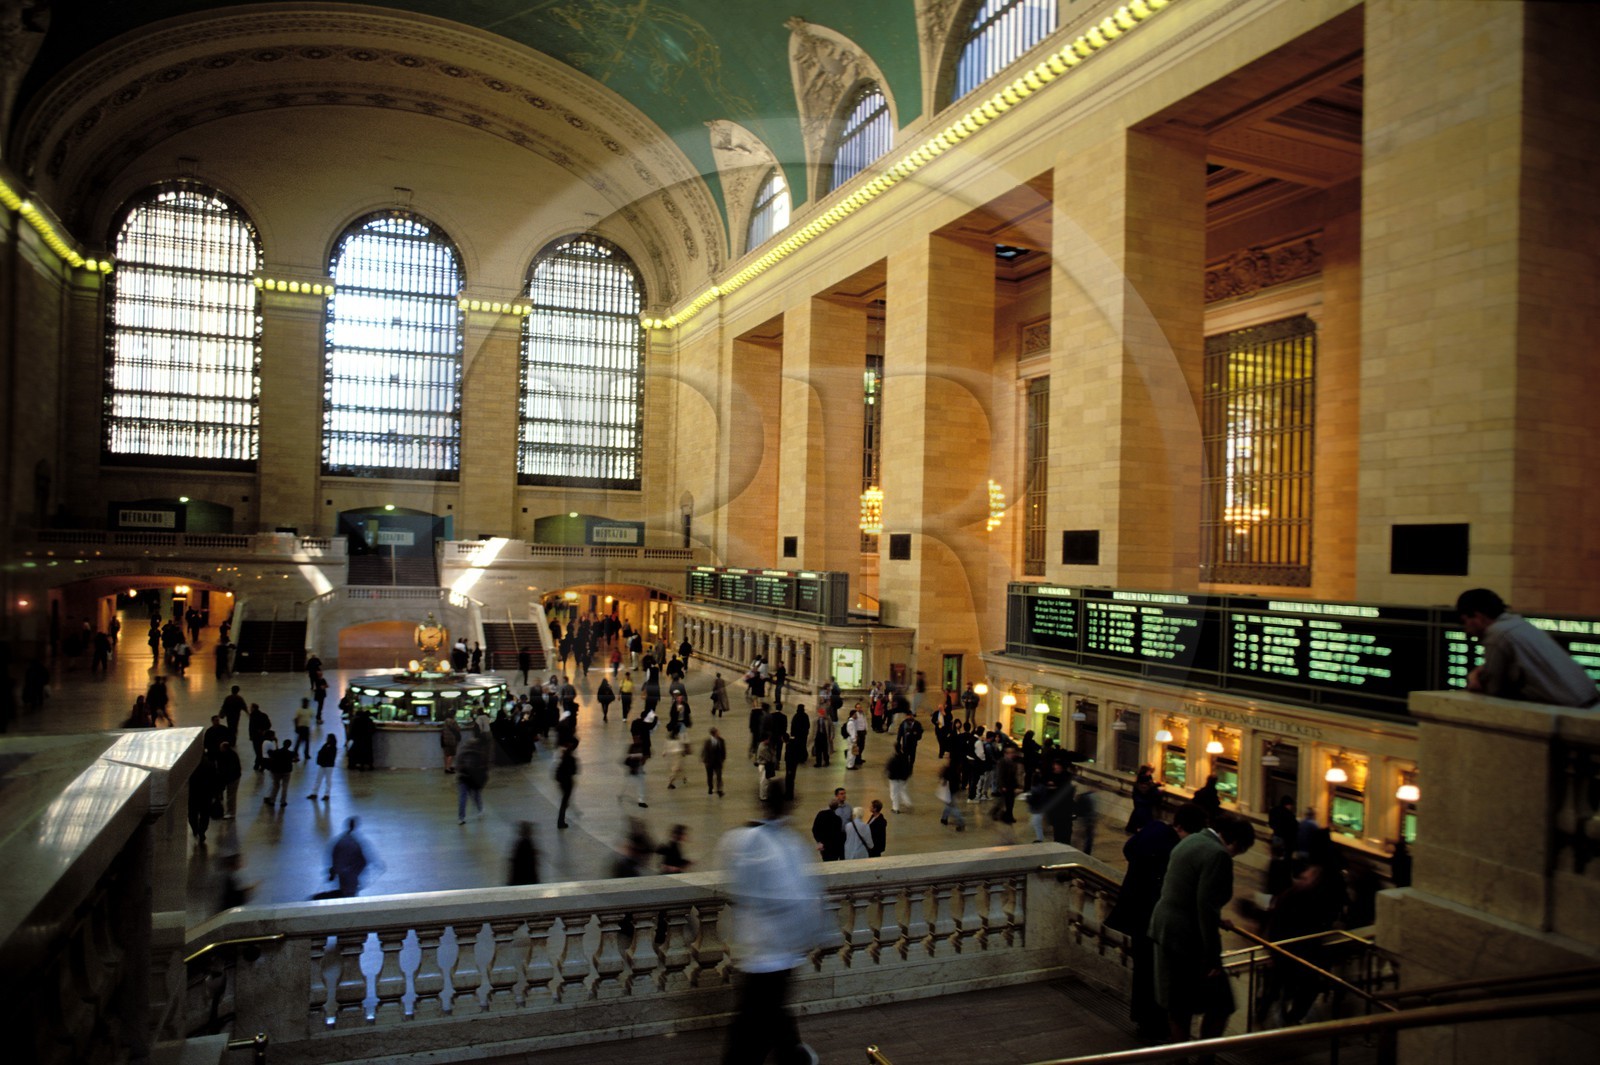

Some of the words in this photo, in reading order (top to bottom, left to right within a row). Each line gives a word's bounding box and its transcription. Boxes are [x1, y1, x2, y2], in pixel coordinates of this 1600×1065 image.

[1184, 702, 1202, 716] MTA
[1205, 706, 1275, 731] METRO-NORTH
[1279, 720, 1322, 739] TICKETS
